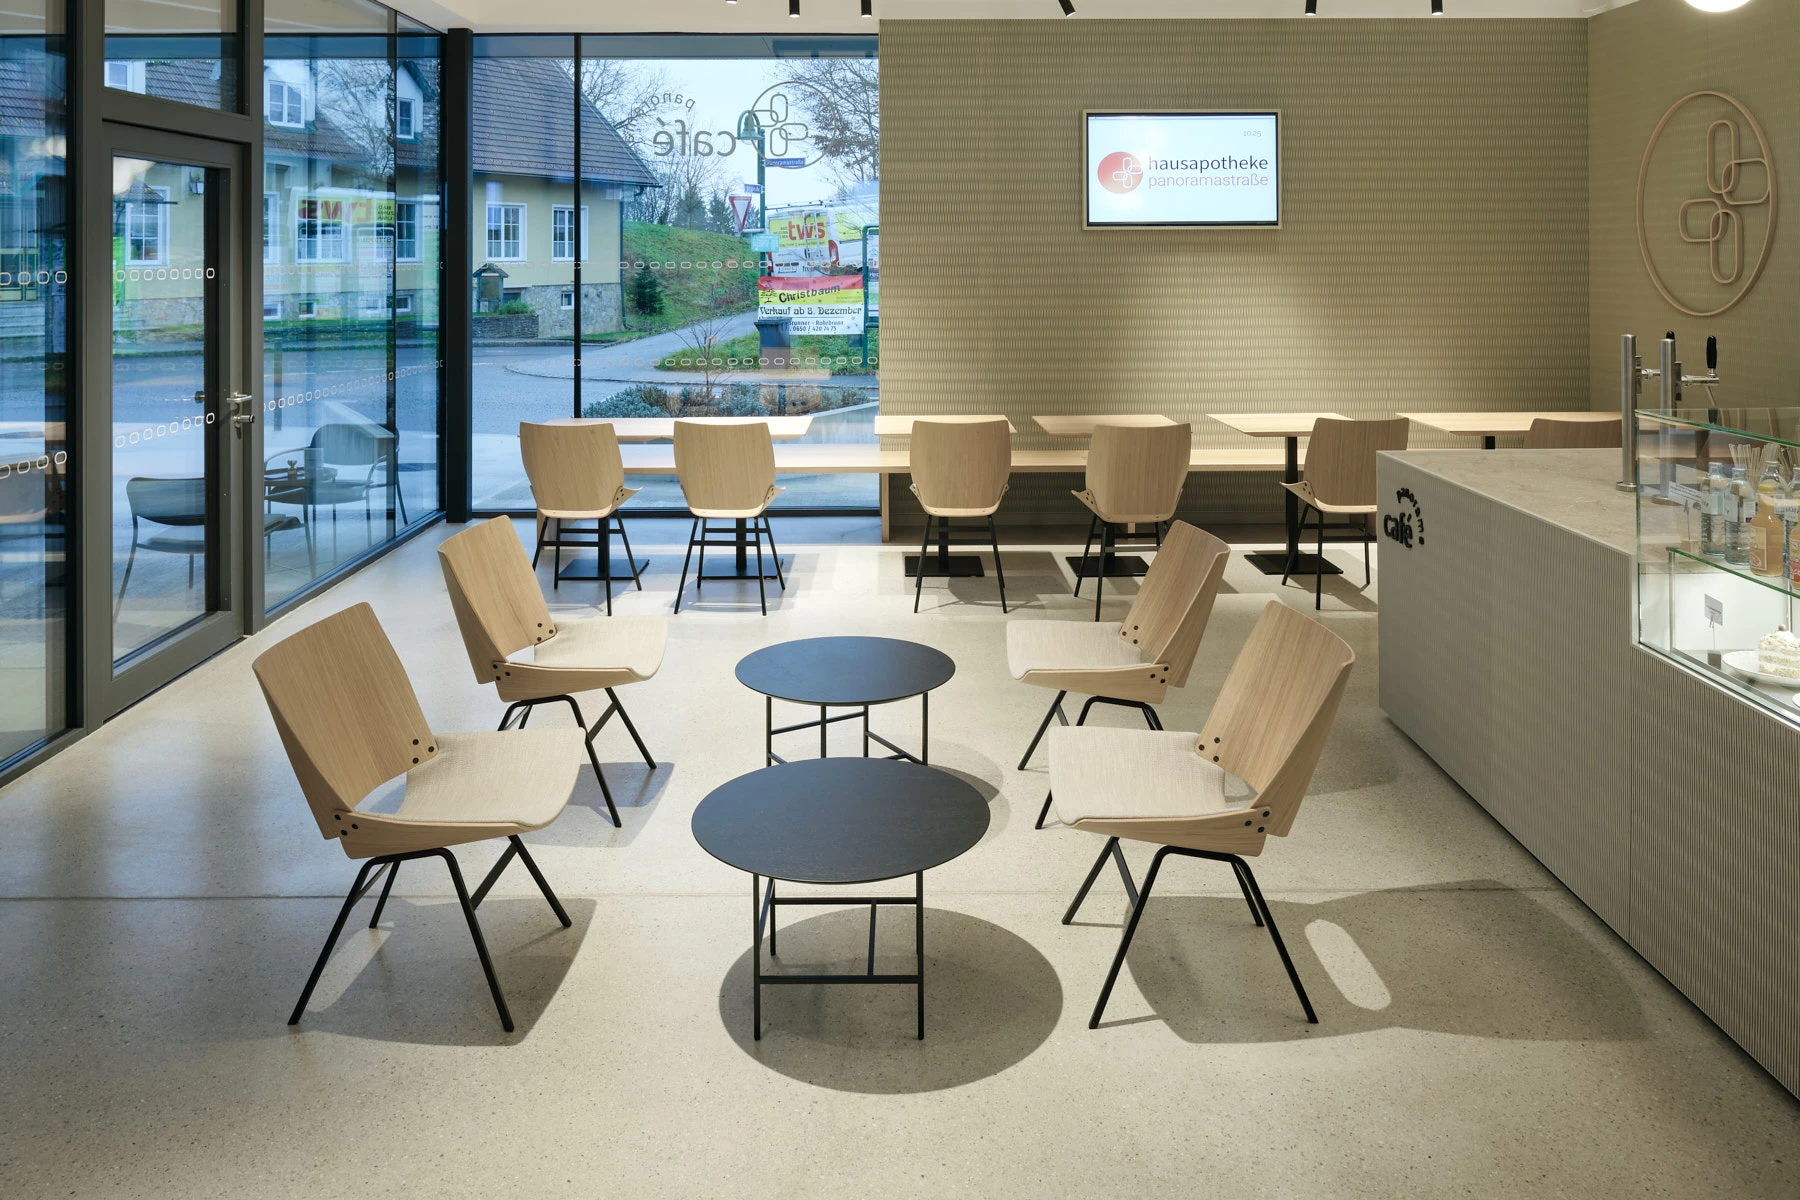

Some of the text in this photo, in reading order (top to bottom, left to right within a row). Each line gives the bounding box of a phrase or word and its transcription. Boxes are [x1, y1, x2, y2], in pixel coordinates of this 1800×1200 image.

[1148, 155, 1269, 174] hausapotheke
[1148, 173, 1269, 189] panoramastraße
[787, 220, 826, 241] tws
[778, 284, 841, 303] Christbaum
[760, 307, 862, 315] Verkauf ab 8. Dezember
[1396, 487, 1425, 546] panorama
[1383, 512, 1413, 549] café
